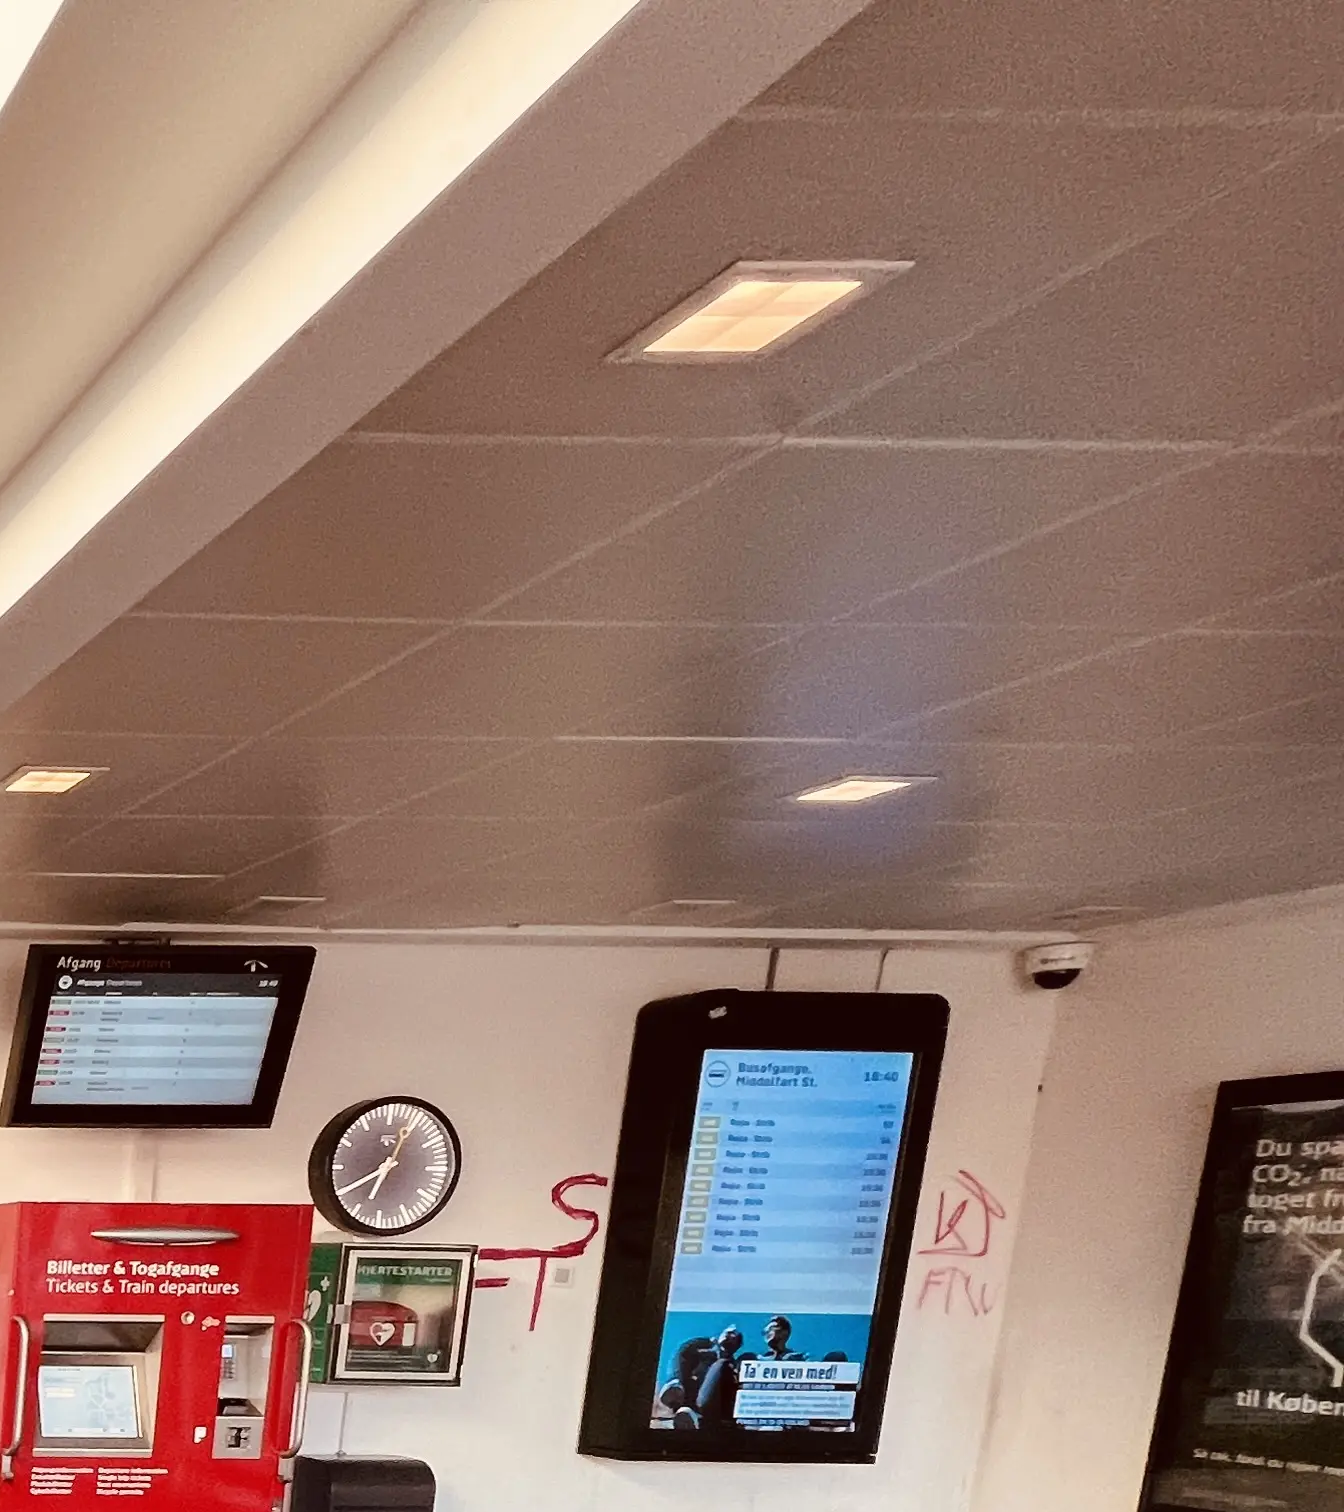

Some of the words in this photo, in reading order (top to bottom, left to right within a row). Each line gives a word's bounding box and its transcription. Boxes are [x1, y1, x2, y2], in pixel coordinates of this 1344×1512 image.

[57, 957, 101, 971] Afgang
[801, 1076, 819, 1087] St.
[1256, 1139, 1292, 1157] Du
[1243, 1214, 1276, 1234] fra
[46, 1260, 110, 1275] Billetter
[113, 1261, 126, 1275] &
[129, 1261, 220, 1278] Togafgange
[46, 1278, 98, 1294] Tickets
[102, 1279, 114, 1293] &
[119, 1279, 155, 1294] Train
[159, 1280, 239, 1296] departures
[763, 1367, 778, 1379] en
[781, 1367, 803, 1379] ven
[806, 1364, 838, 1379] med!
[1236, 1389, 1260, 1408] til
